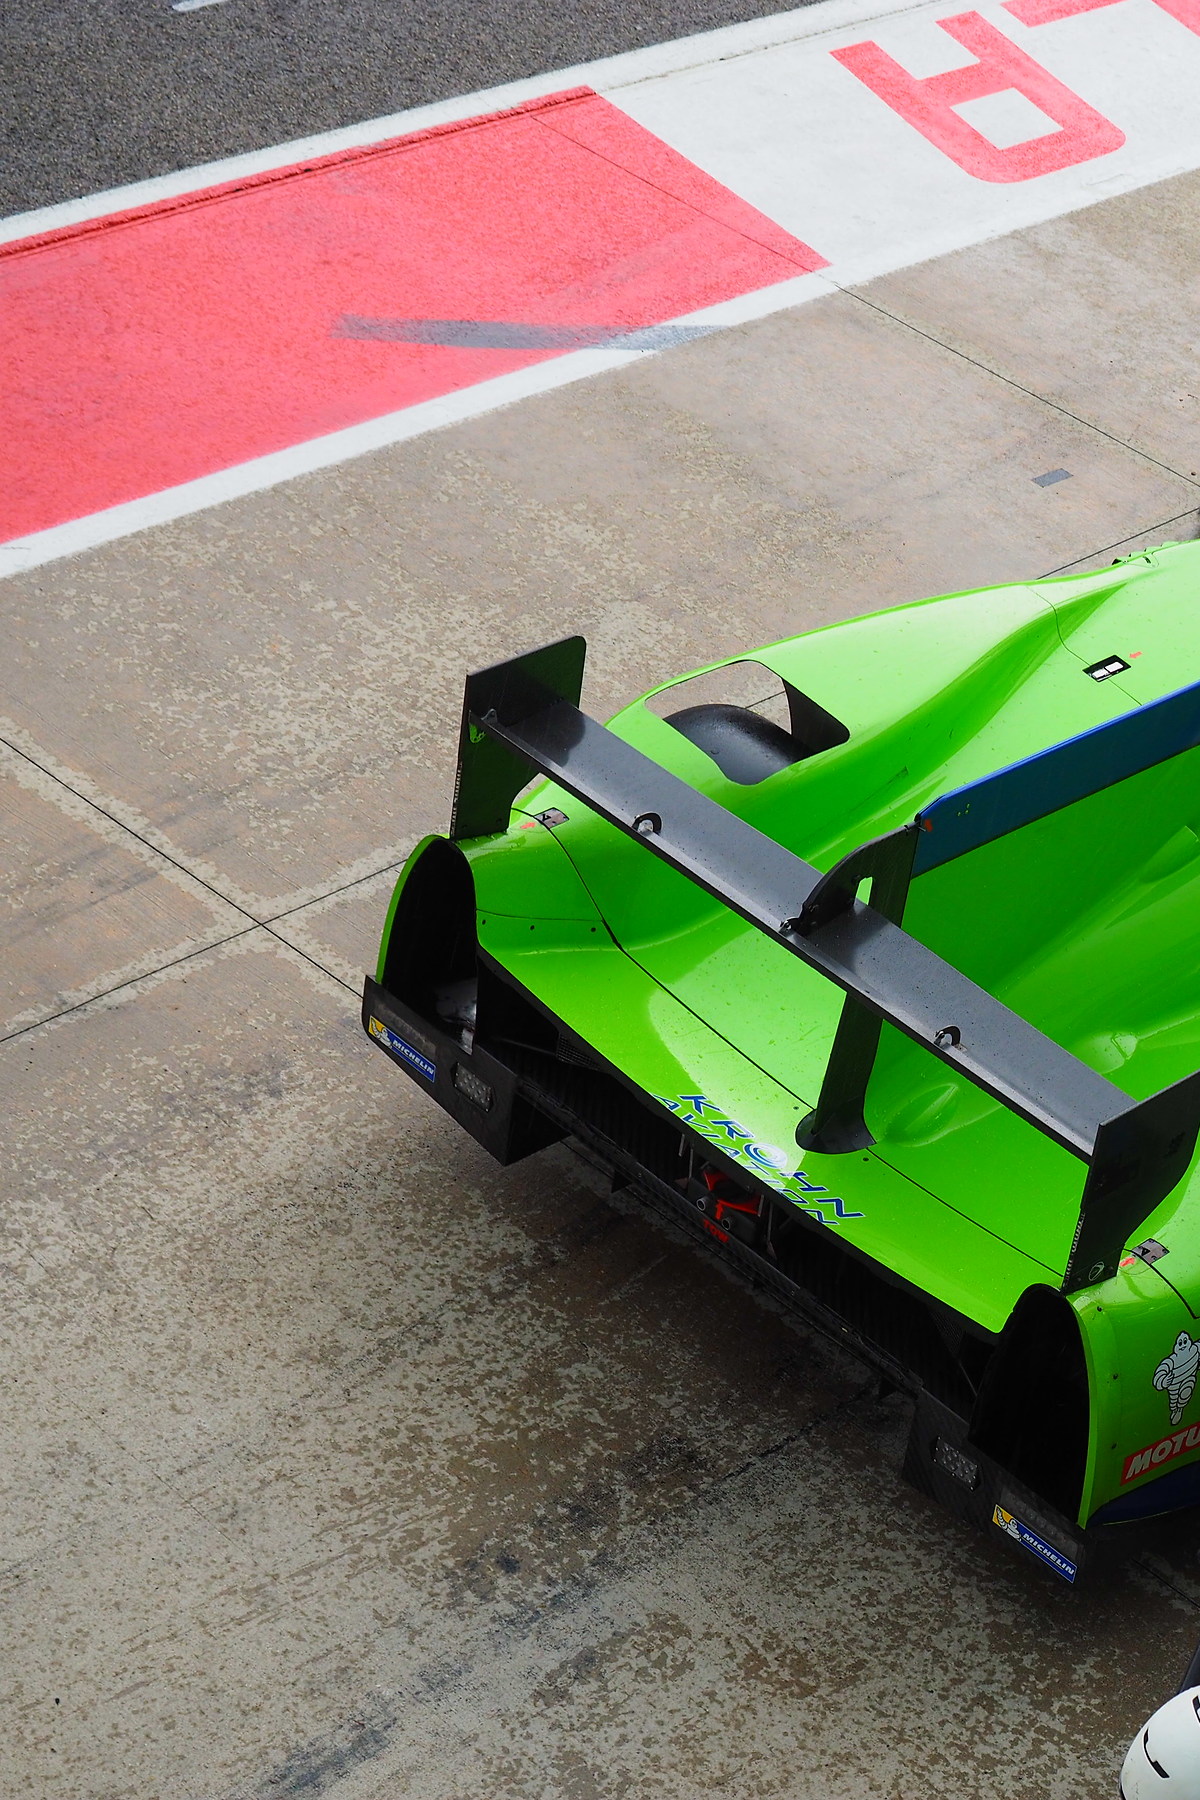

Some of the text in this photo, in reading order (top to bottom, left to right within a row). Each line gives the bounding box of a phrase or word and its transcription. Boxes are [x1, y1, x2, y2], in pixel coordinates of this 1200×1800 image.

[392, 1039, 435, 1075] MICHELIN
[651, 1094, 840, 1226] AVIATION
[679, 1095, 866, 1218] KROHN
[703, 1220, 730, 1243] TOW
[1022, 1532, 1076, 1577] MICHELIN
